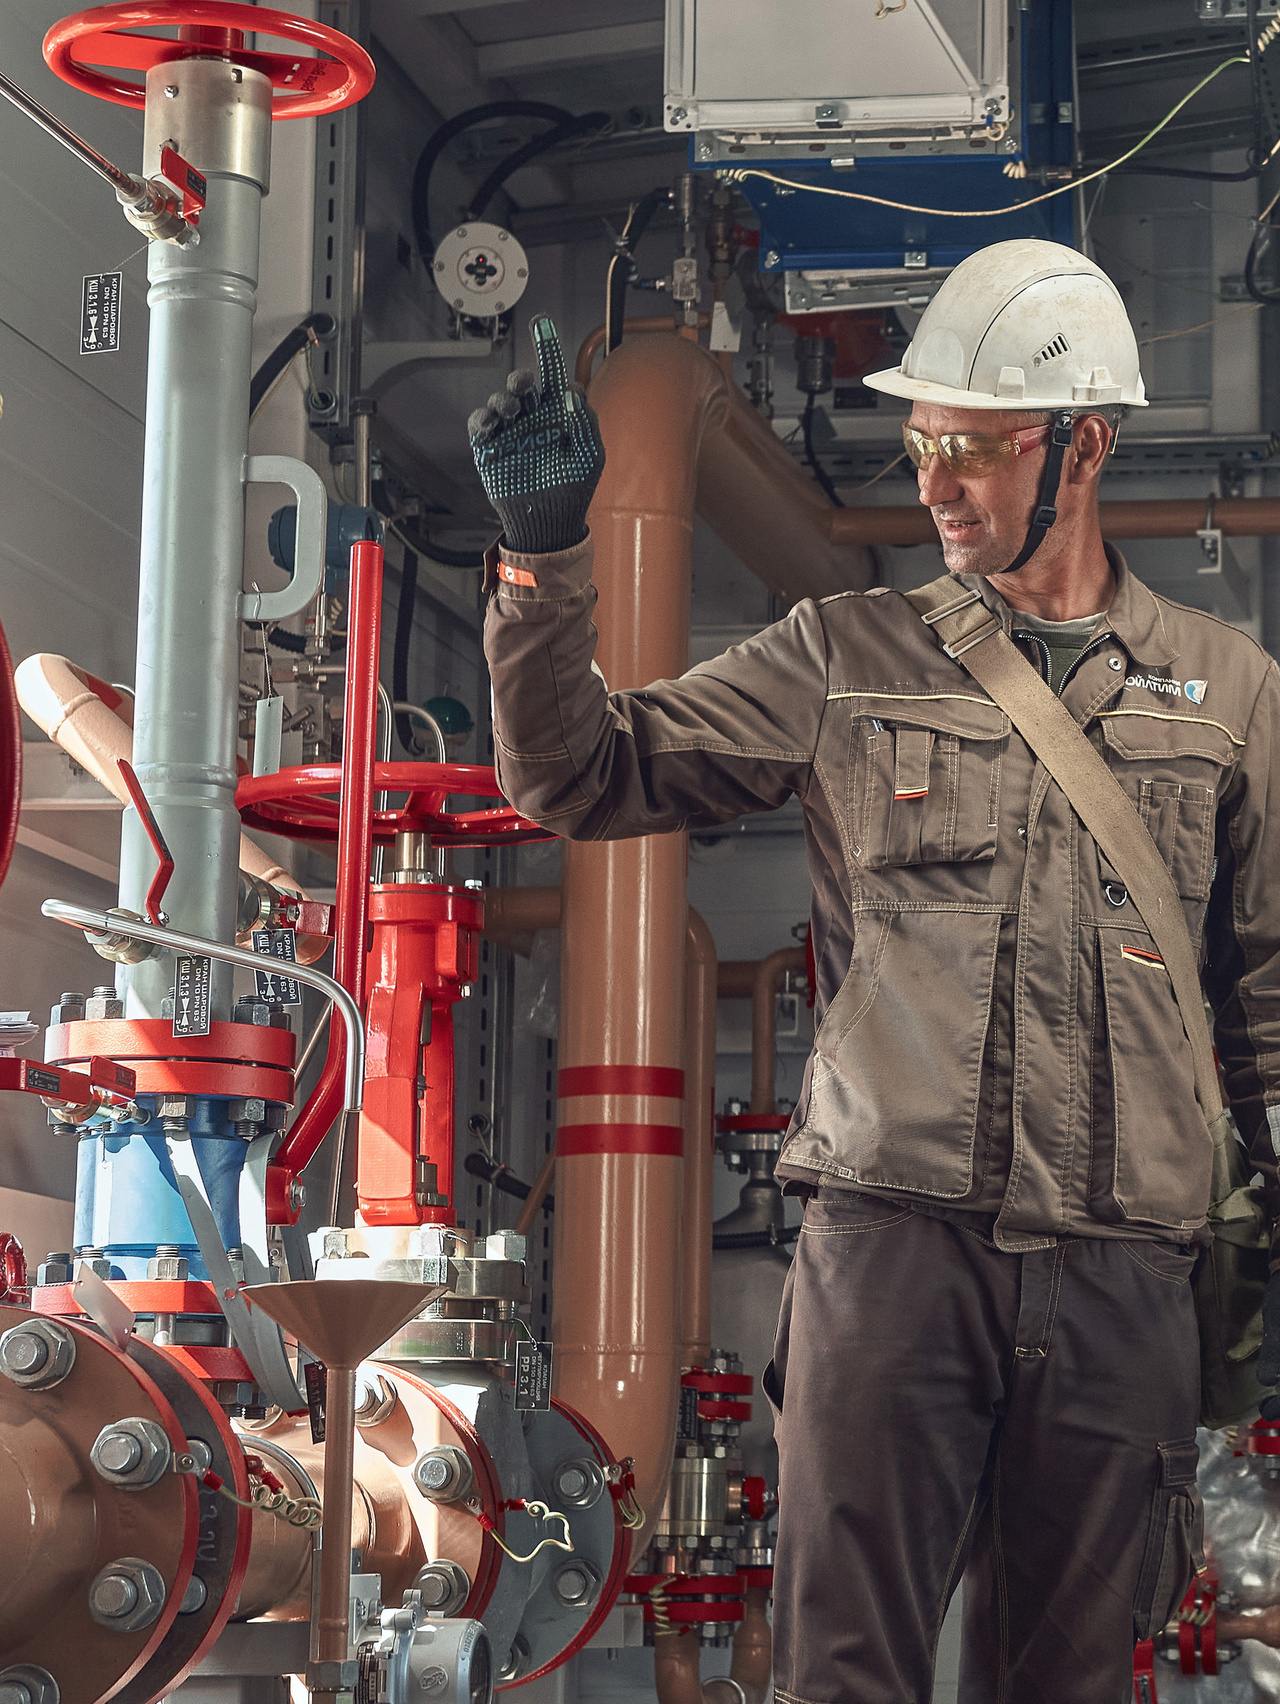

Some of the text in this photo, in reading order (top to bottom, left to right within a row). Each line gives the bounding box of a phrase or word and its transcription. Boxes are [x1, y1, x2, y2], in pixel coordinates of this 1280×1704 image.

[88, 280, 98, 314] КШ 3.1.6
[103, 287, 110, 338] DN 10 PN 63
[259, 934, 269, 946] КШ
[277, 943, 282, 954] DN
[180, 960, 190, 996] КШ 3.1.3
[194, 968, 201, 1021] DN 10 PN 63
[532, 1356, 536, 1364] DN
[520, 1376, 528, 1394] 3.1
[531, 1379, 535, 1387] PN
